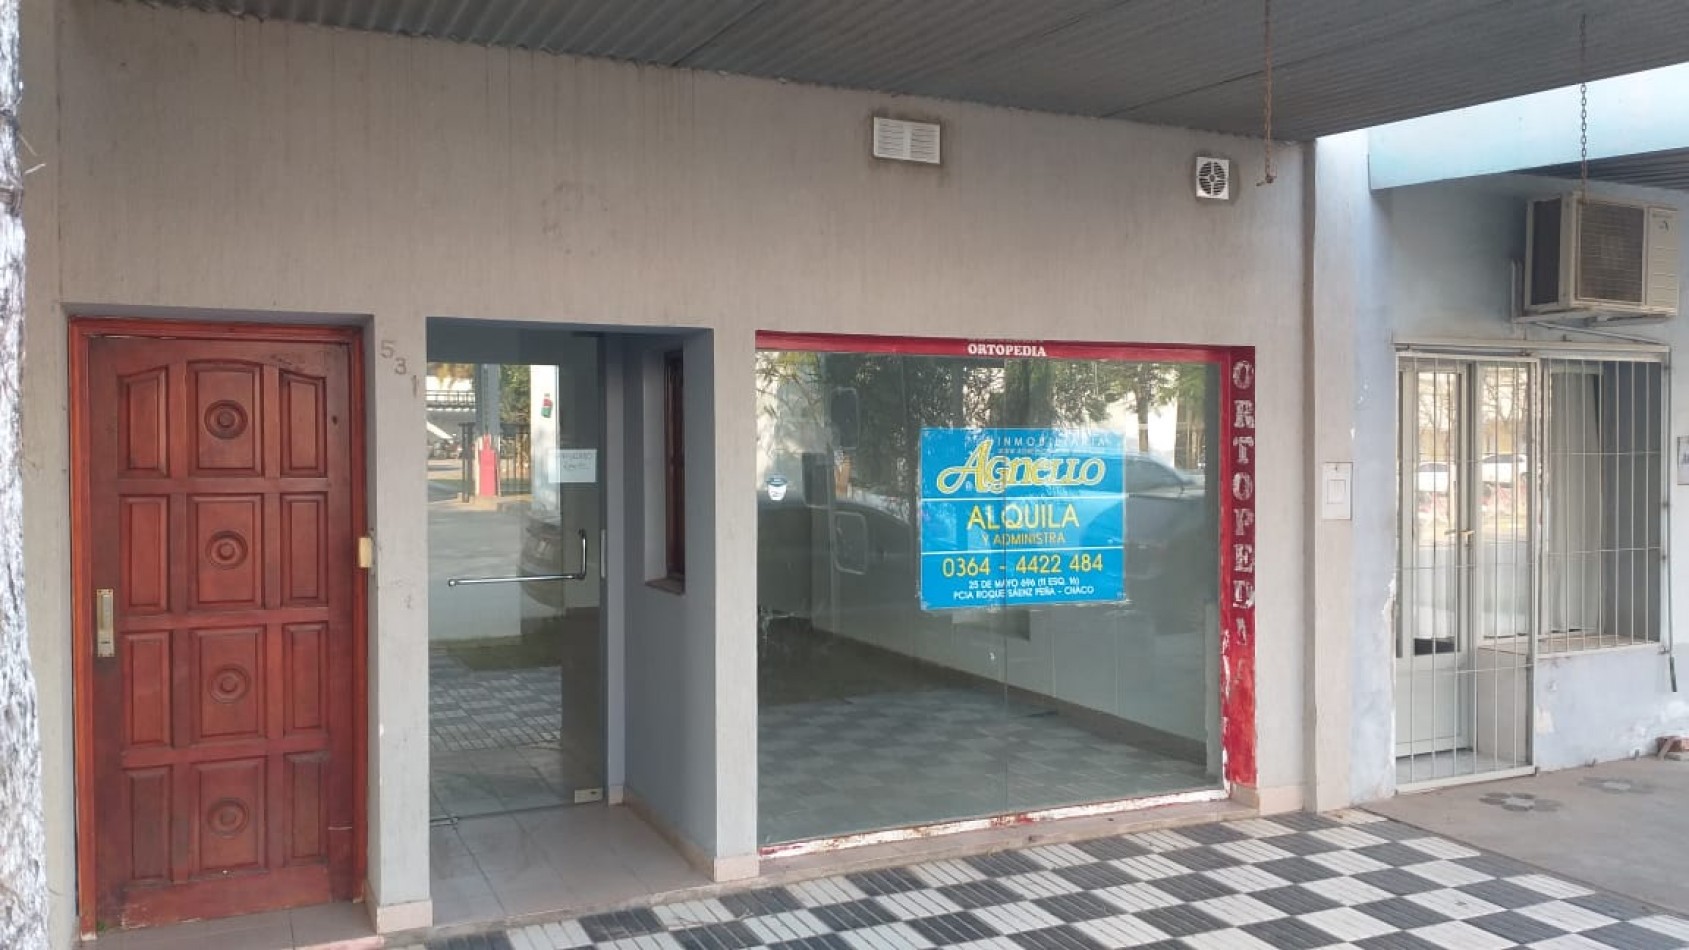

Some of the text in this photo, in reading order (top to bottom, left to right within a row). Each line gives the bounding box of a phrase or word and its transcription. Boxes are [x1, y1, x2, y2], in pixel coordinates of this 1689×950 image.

[967, 343, 1047, 357] ORTOPEDIA
[967, 503, 1080, 530] ALQUILA
[1232, 360, 1255, 683] ORTOPEDI
[993, 531, 1066, 546] ADMINISTRA
[942, 556, 991, 577] 0364
[1015, 554, 1062, 574] 4422
[1069, 553, 1103, 572] 484
[980, 580, 992, 589] DE
[995, 578, 1019, 588] MAYO
[953, 590, 974, 600] PCIA
[976, 588, 1006, 599] ROQUE
[1064, 585, 1095, 596] CHACO
